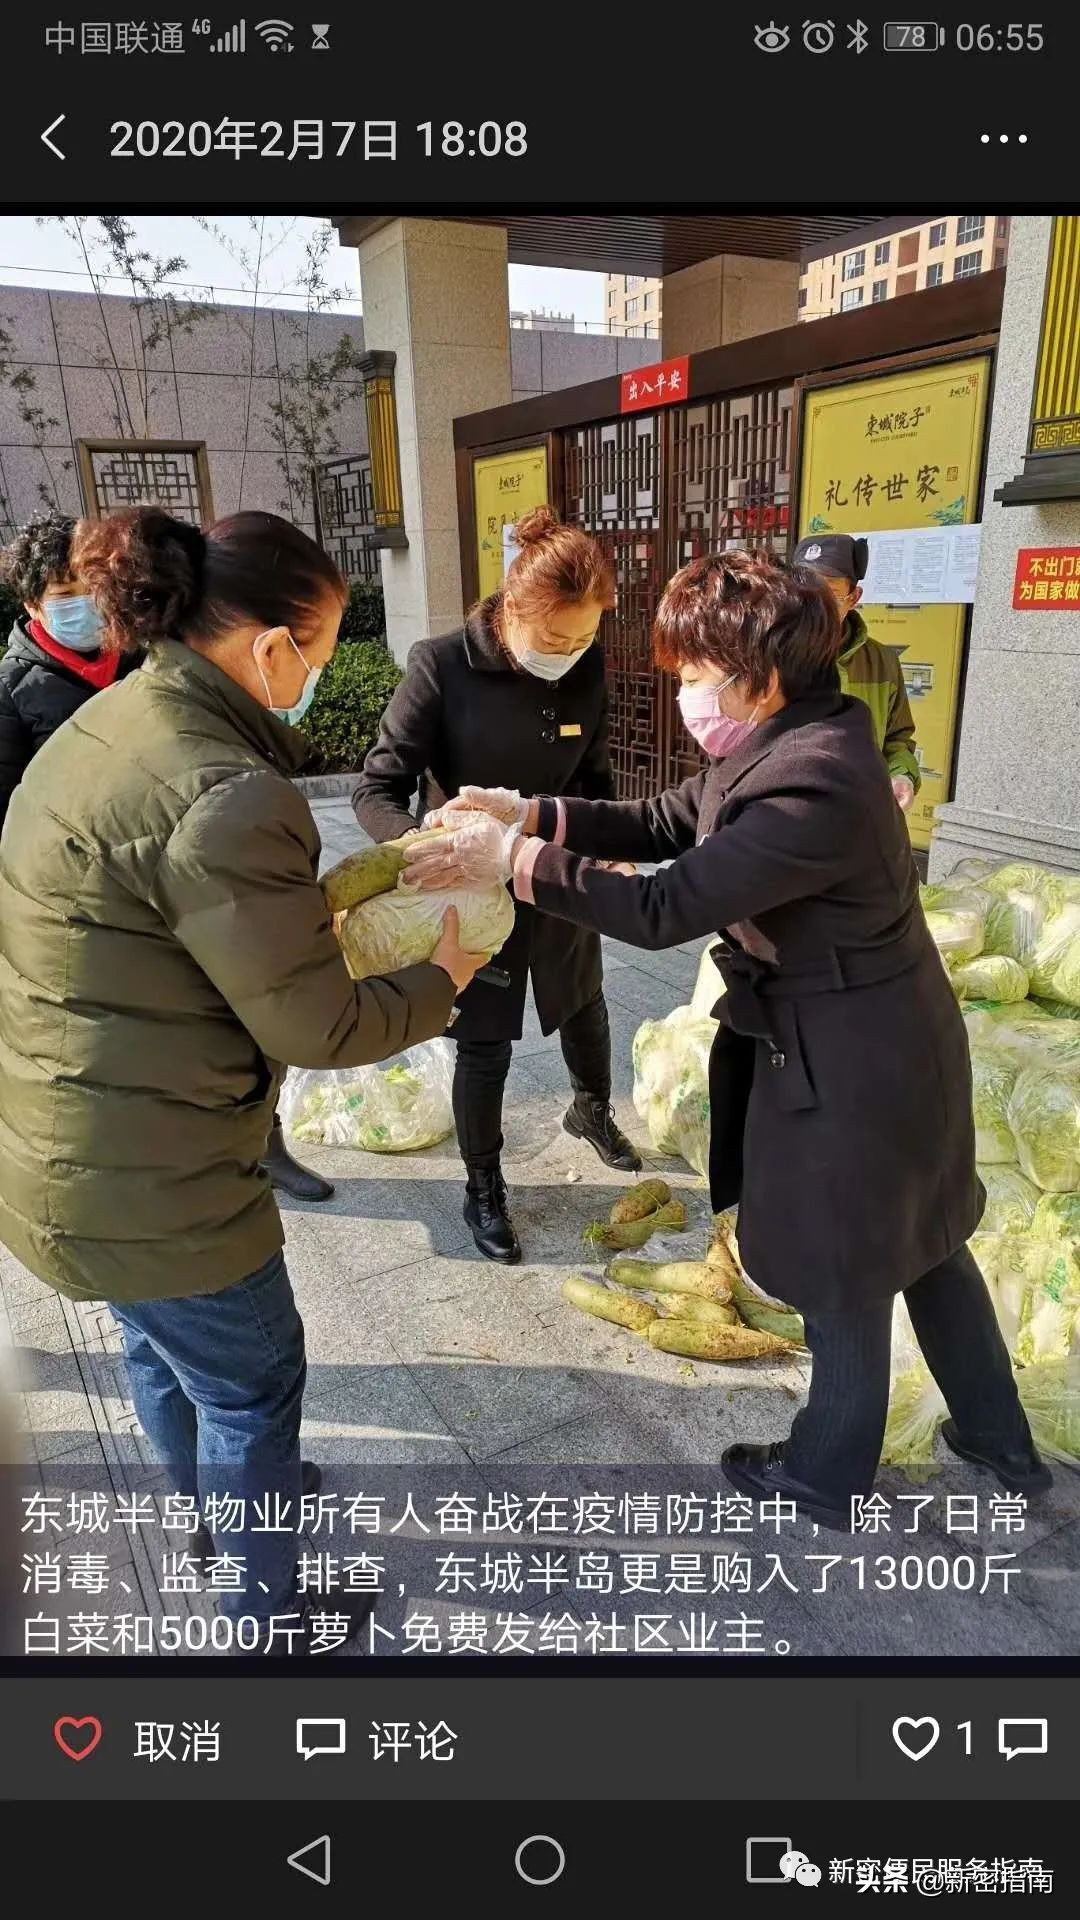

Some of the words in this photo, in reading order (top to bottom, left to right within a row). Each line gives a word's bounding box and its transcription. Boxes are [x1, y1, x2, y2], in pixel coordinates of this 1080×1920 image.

[629, 369, 682, 401] 出入平安
[825, 465, 940, 511] 礼传世家
